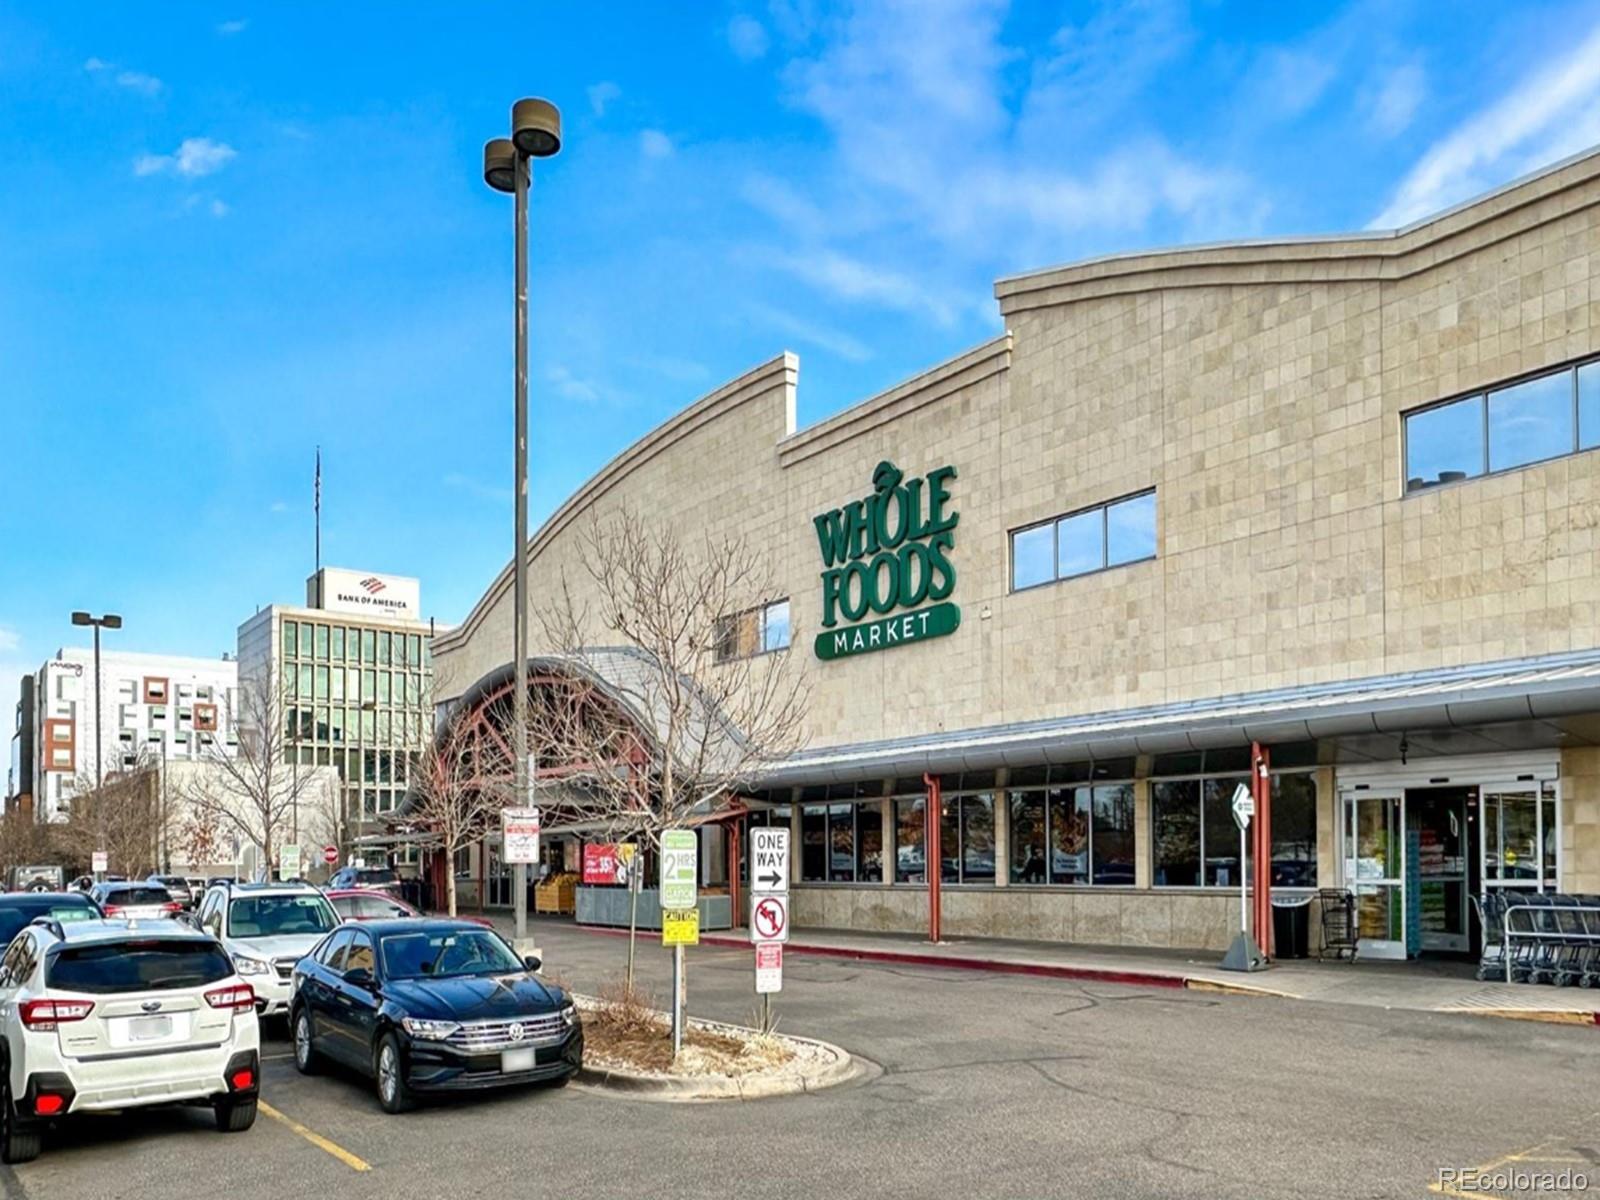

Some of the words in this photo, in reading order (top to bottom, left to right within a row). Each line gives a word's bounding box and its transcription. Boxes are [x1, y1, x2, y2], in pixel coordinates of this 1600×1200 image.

[813, 464, 960, 567] WHOLE
[820, 532, 957, 628] FOODS
[338, 594, 359, 603] BANK
[372, 598, 407, 608] AMERICA
[834, 612, 930, 654] MARKET
[757, 834, 784, 850] ONE
[664, 853, 676, 880] 2
[677, 853, 696, 867] HRS
[757, 852, 785, 867] WAY
